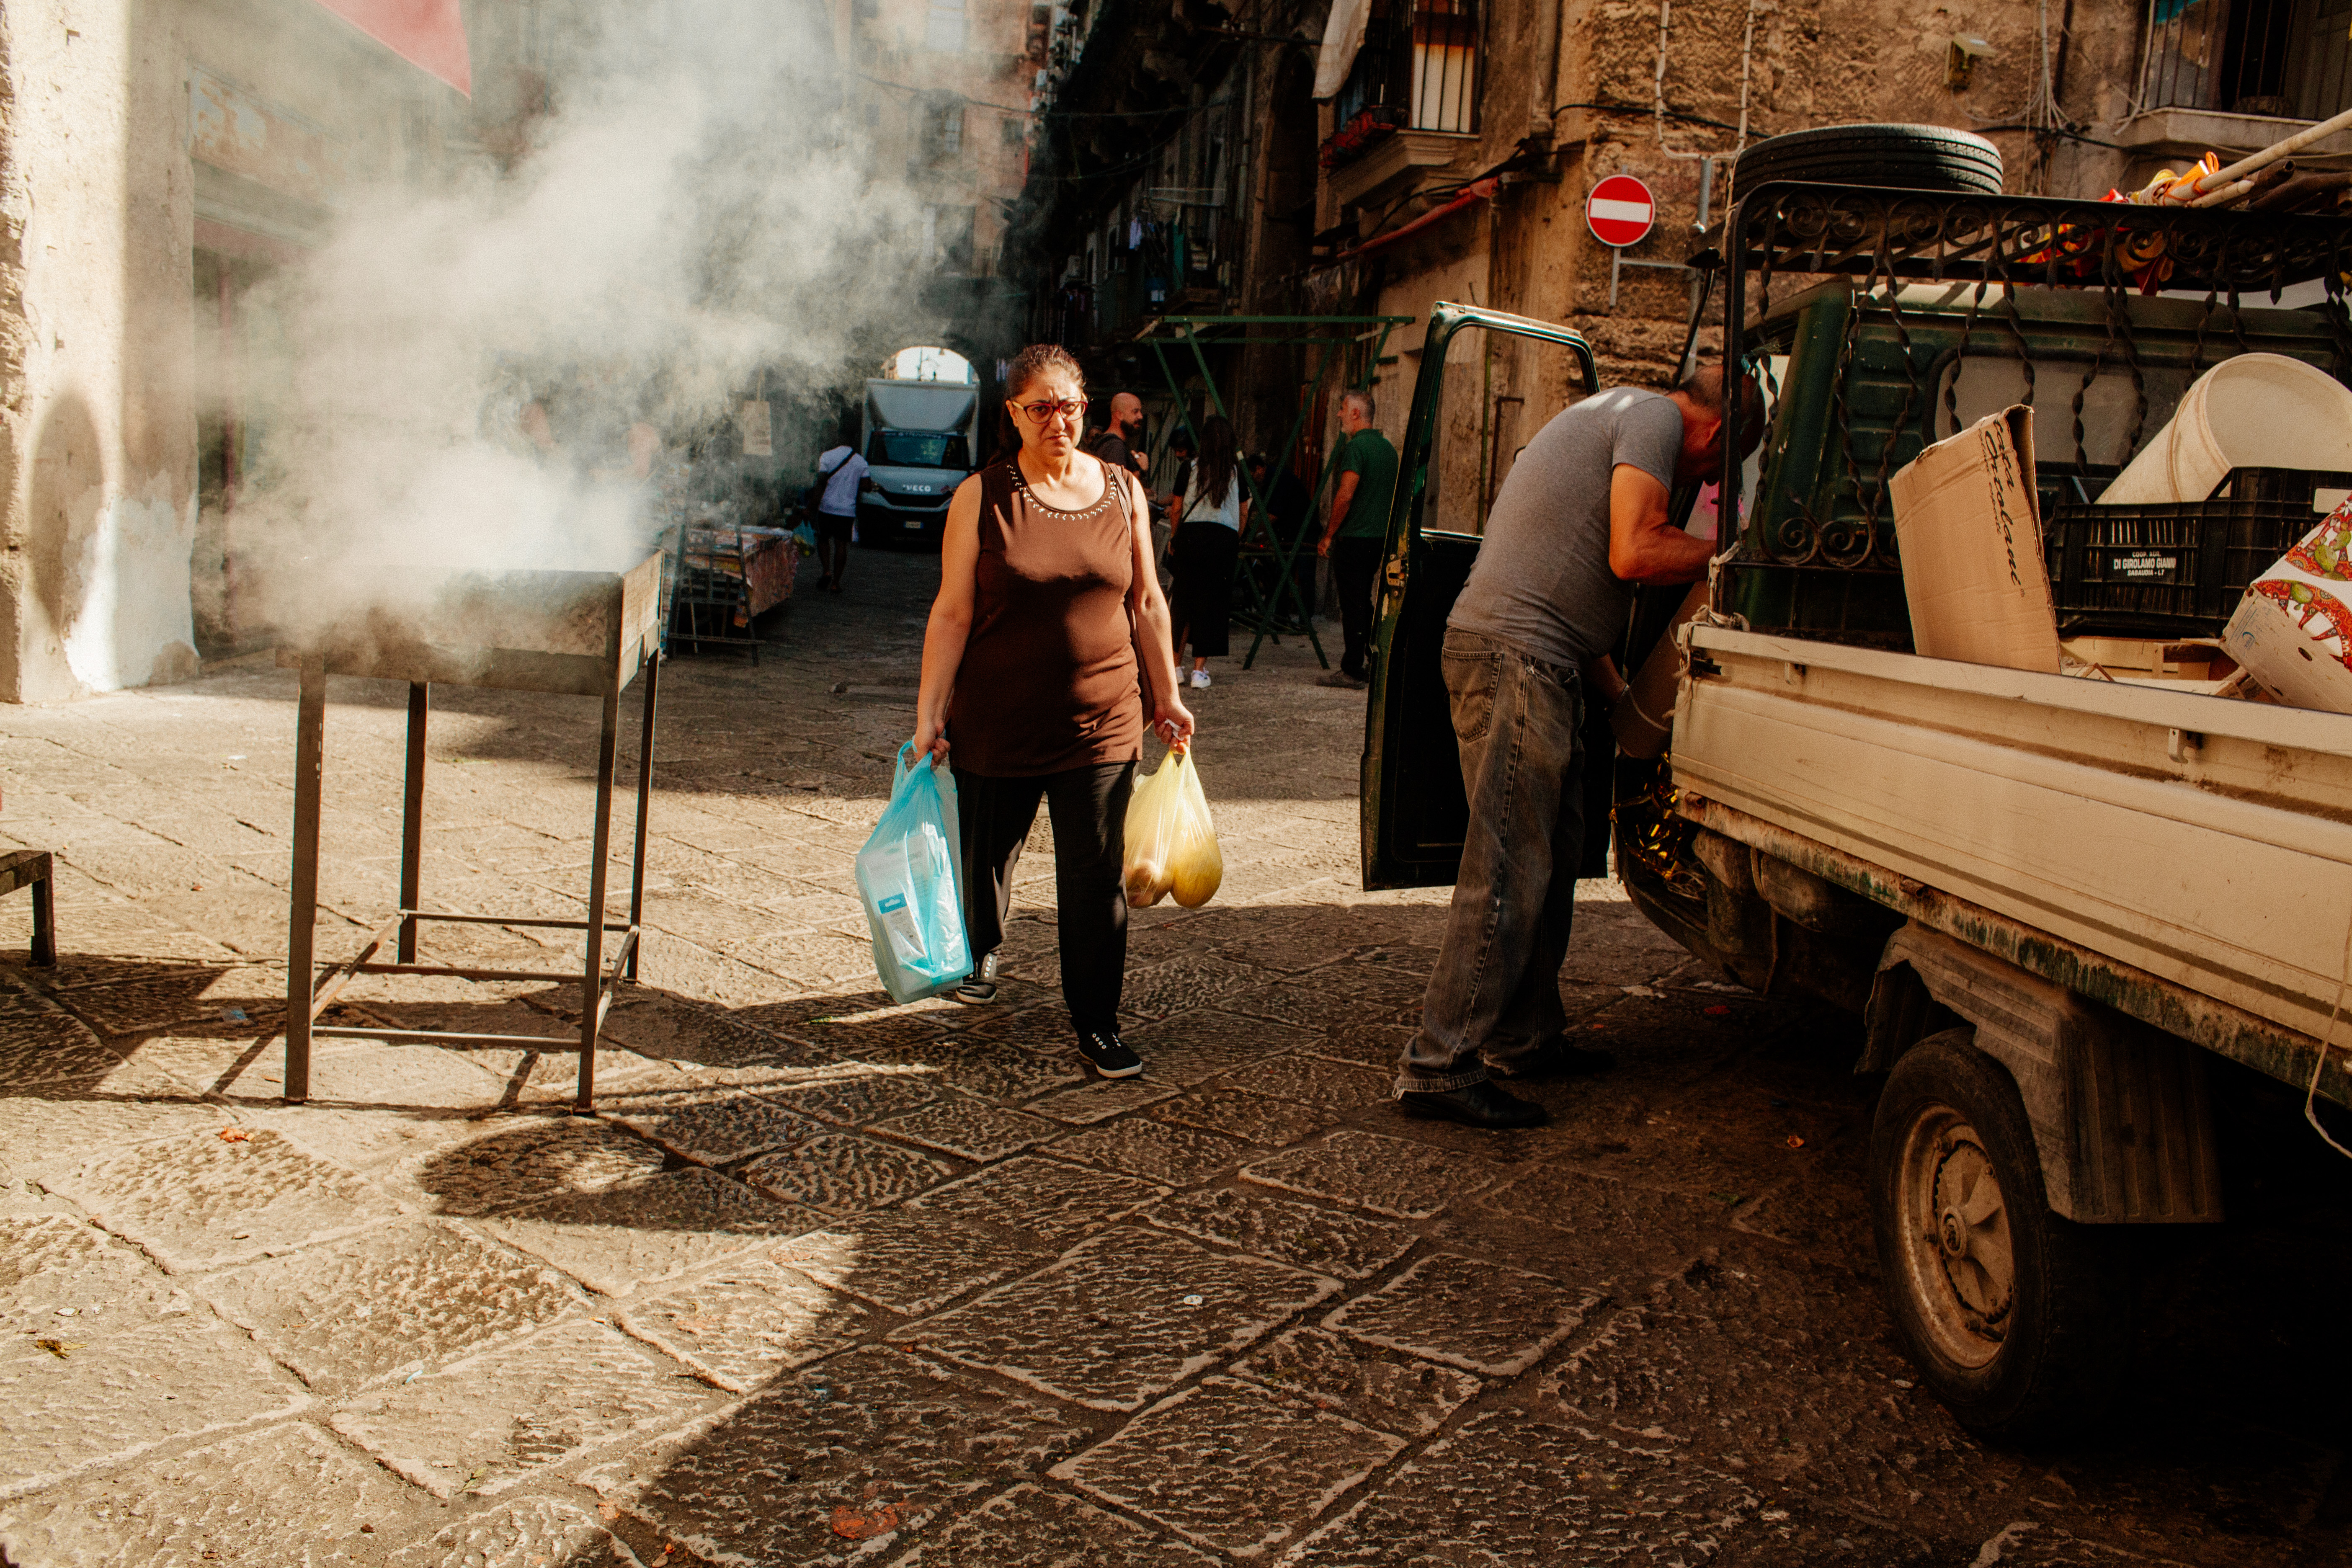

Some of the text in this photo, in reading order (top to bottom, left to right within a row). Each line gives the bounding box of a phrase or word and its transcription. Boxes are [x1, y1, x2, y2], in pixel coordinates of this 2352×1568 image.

[1985, 431, 2021, 585] Ortolani
[2113, 558, 2121, 570] DI
[2122, 558, 2155, 569] GIROLAMO
